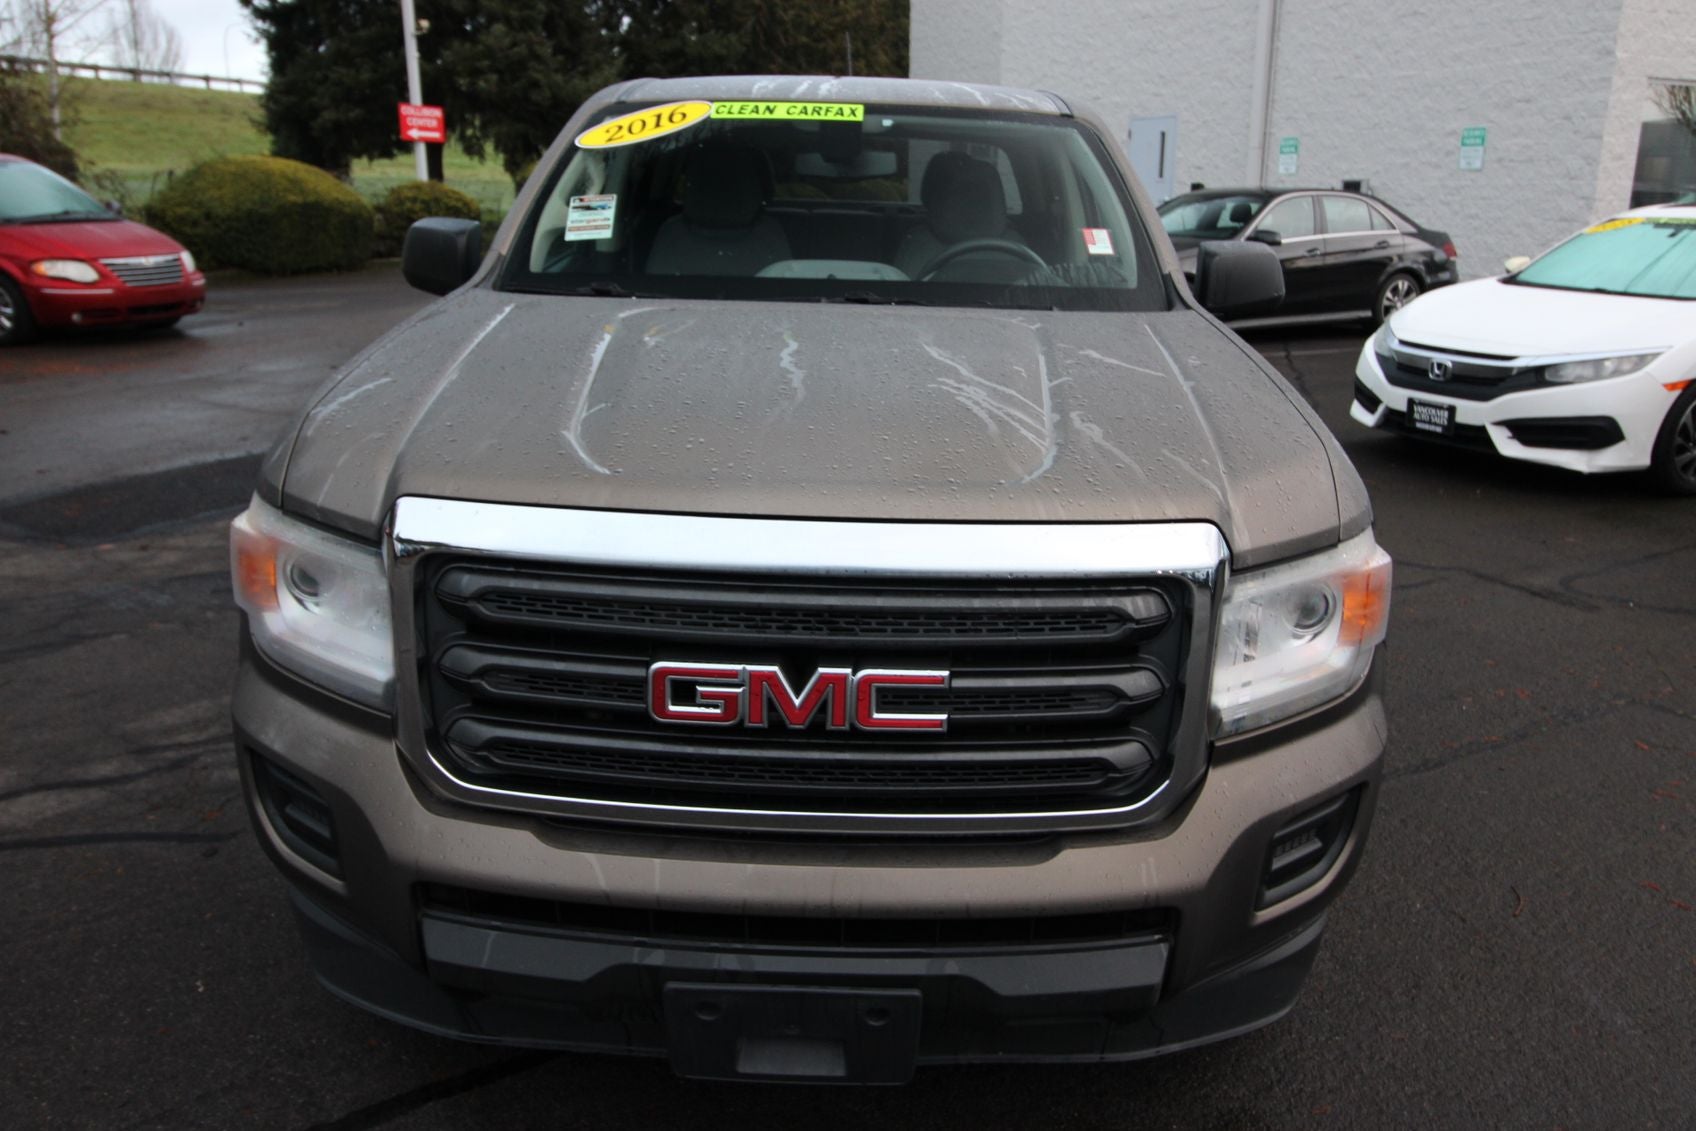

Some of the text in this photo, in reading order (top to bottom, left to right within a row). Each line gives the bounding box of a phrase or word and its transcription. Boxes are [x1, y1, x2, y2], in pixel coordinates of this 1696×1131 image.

[604, 103, 689, 143] 2016
[714, 103, 859, 118] CLEAN CARFAX
[647, 661, 951, 733] GMC
